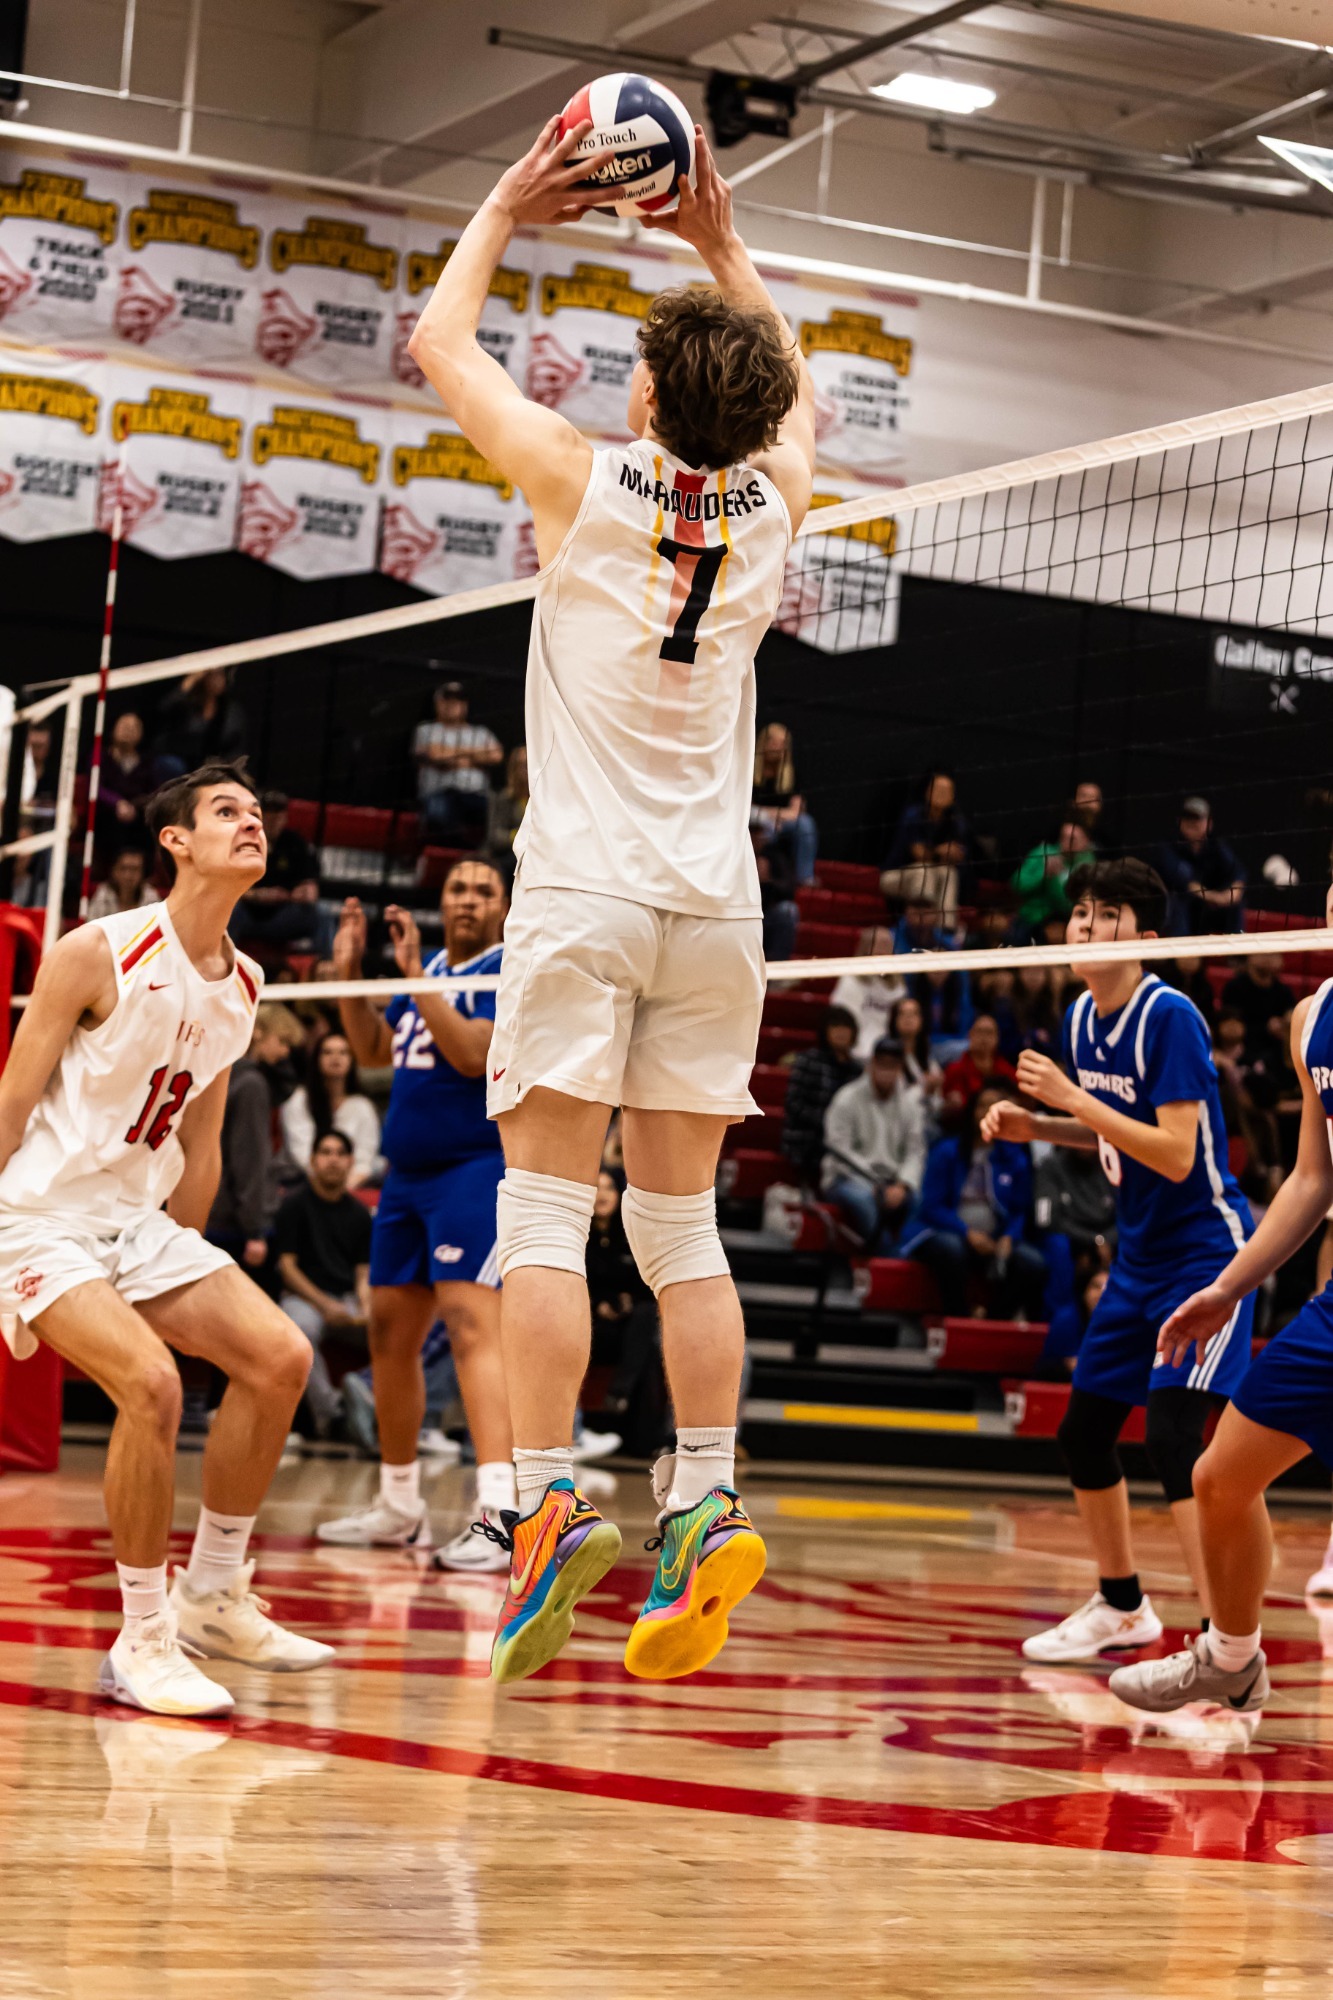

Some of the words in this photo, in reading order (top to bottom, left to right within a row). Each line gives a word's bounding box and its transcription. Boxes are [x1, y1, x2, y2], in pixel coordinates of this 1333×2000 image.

[577, 138, 596, 151] Pro
[597, 128, 637, 146] Touch
[36, 236, 104, 260] TRACK
[175, 278, 244, 300] RUGBY
[316, 301, 383, 322] RUGBY
[158, 472, 227, 493] RUGBY
[619, 463, 767, 523] MARAUDERS
[297, 494, 364, 515] RUGBY
[437, 515, 503, 534] RUGBY
[656, 536, 728, 664] 7
[390, 1010, 436, 1070] 22
[124, 1064, 193, 1151] 12
